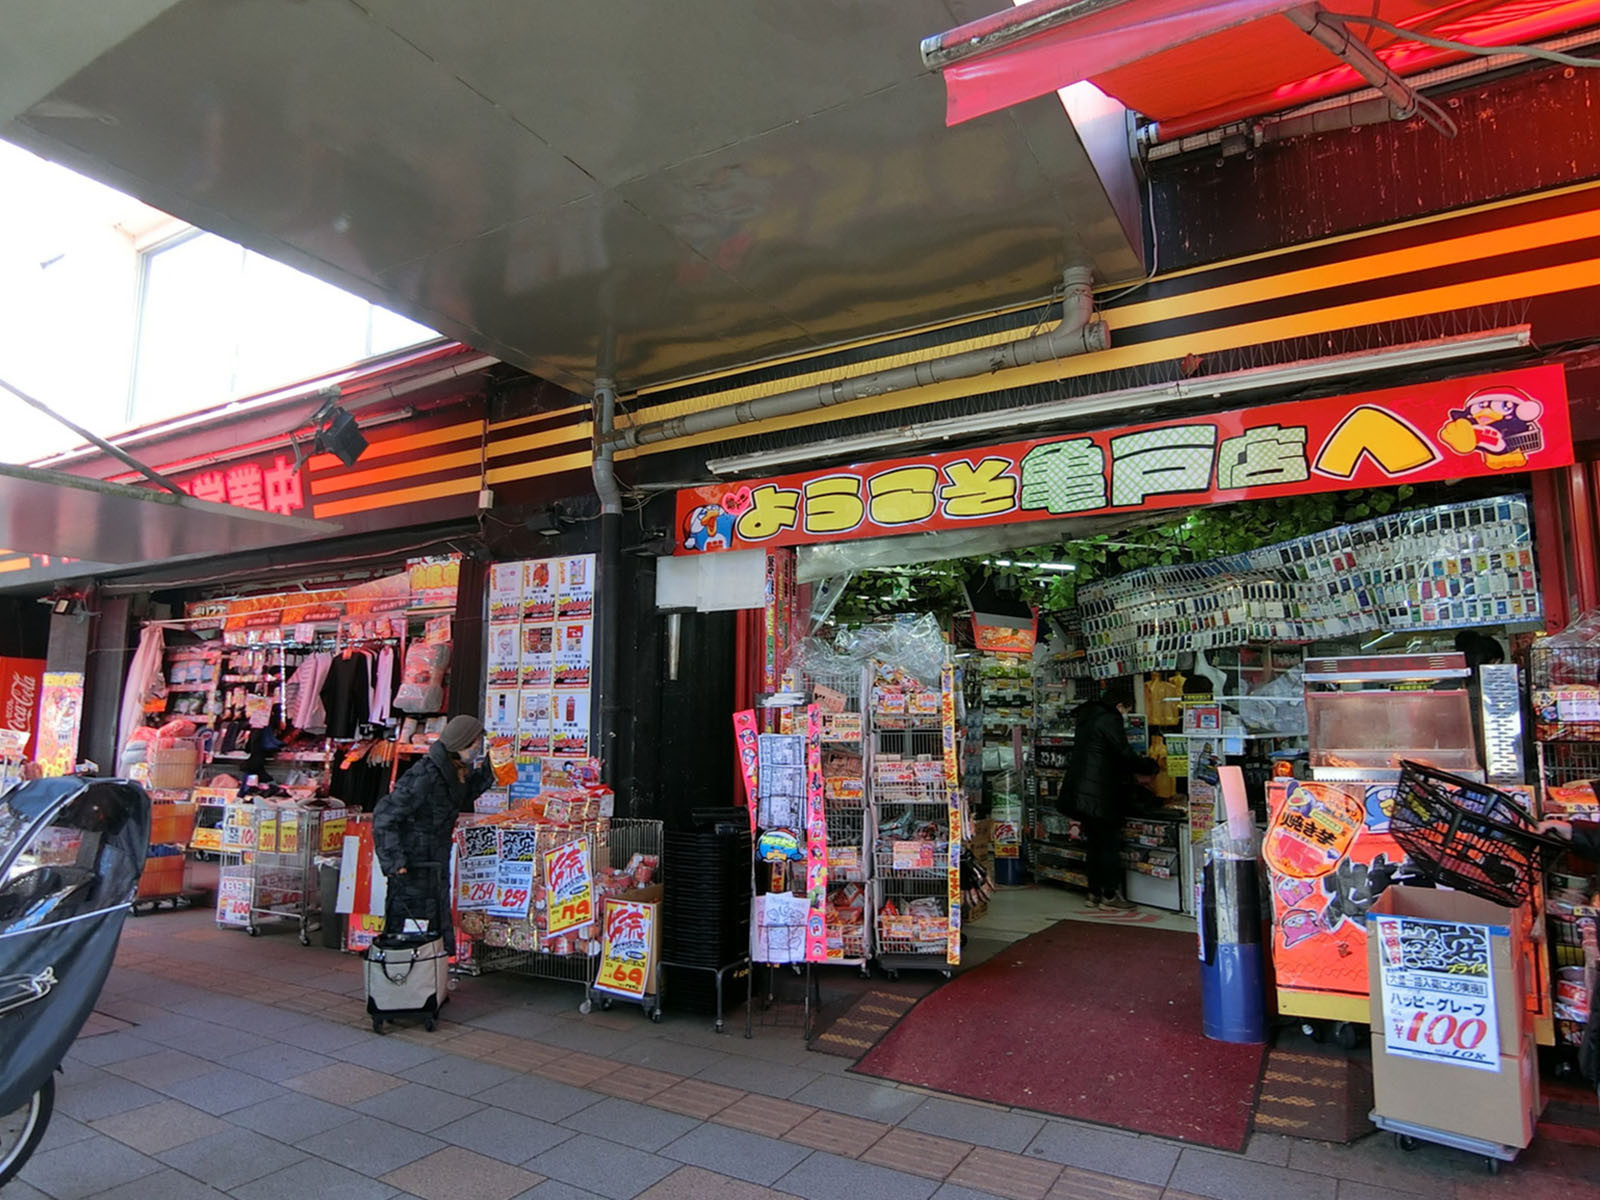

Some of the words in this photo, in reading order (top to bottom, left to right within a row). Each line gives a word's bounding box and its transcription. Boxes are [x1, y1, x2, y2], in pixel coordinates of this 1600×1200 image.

[736, 404, 1443, 541] ようこそ亀戸店へ
[843, 731, 860, 740] 699
[1279, 812, 1337, 846] 焼き芋
[471, 883, 495, 901] 259
[501, 888, 528, 908] 259
[613, 964, 643, 985] 69
[1446, 962, 1489, 974] プライス
[1390, 993, 1486, 1017] ハッピーグレープ
